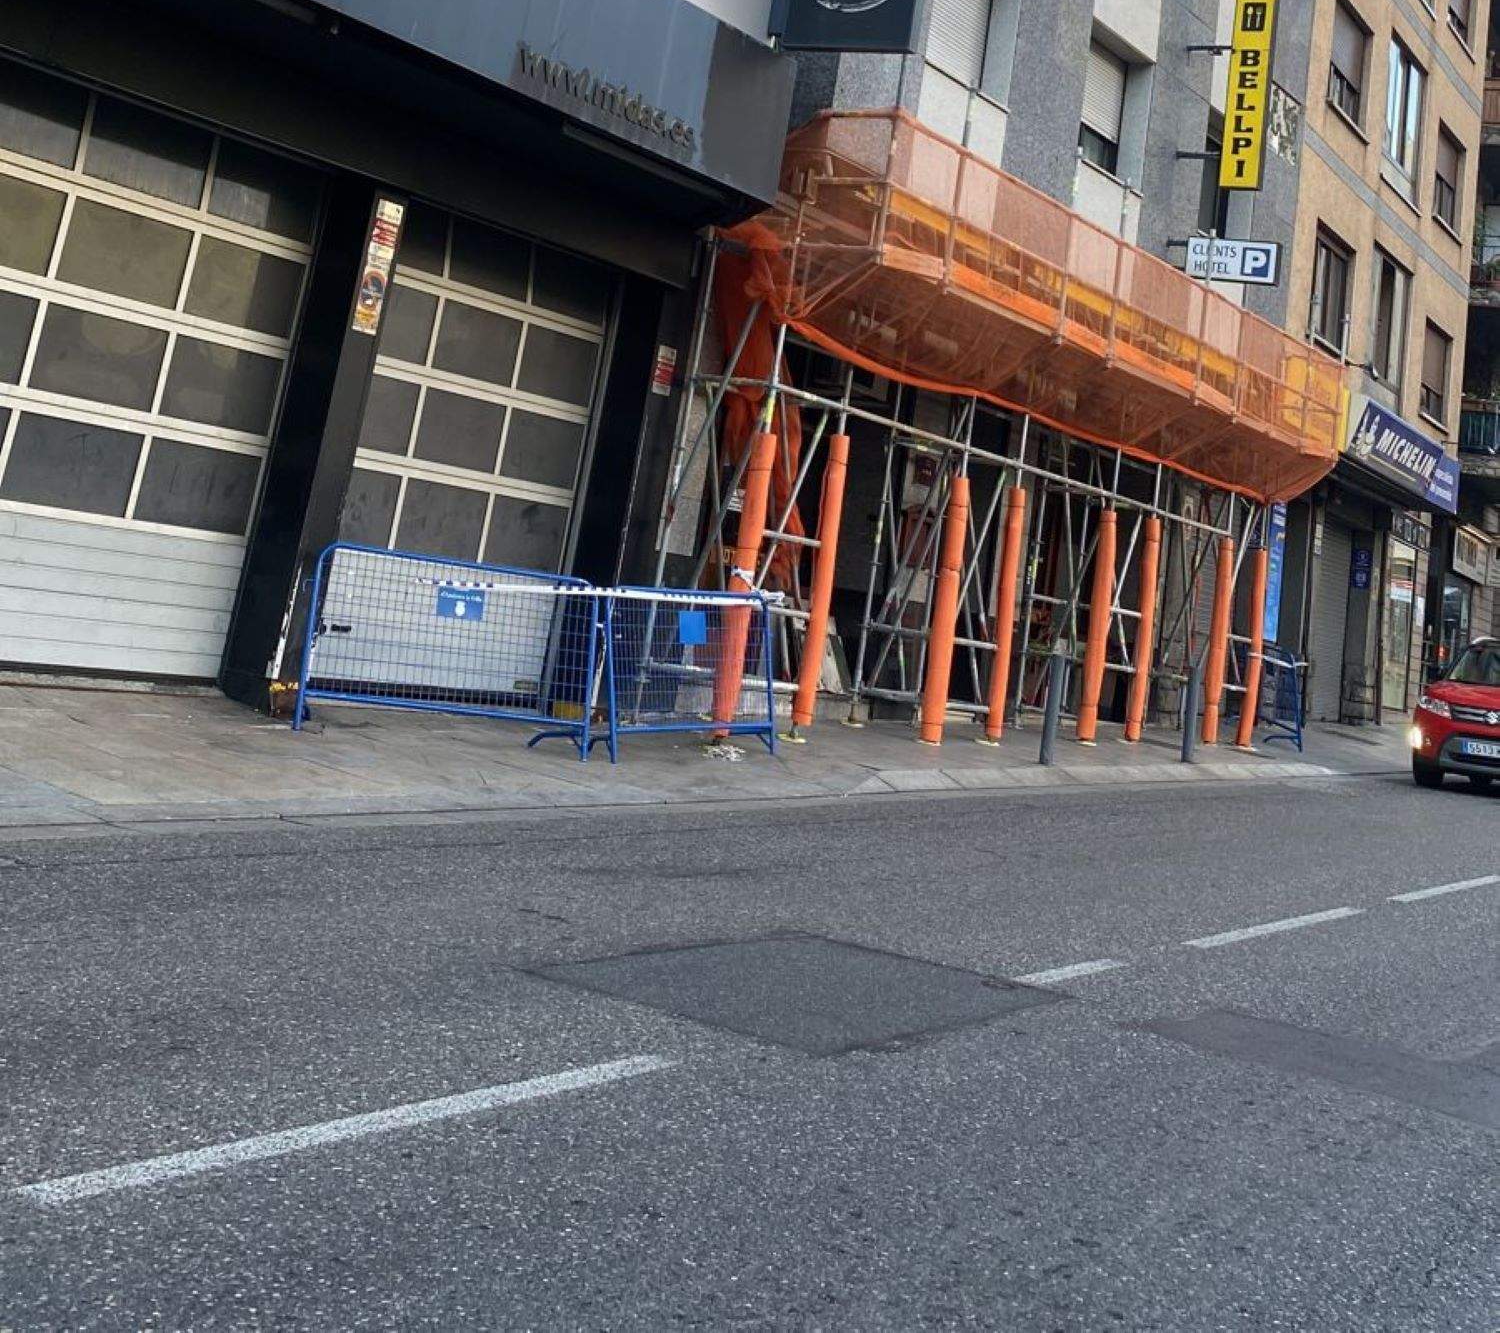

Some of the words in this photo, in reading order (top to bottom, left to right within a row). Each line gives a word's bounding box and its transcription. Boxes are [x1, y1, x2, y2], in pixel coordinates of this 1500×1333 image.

[518, 40, 696, 149] www.midas.es
[1231, 49, 1261, 178] BELLPI
[1243, 250, 1267, 274] P
[1375, 428, 1437, 479] MICHELIN
